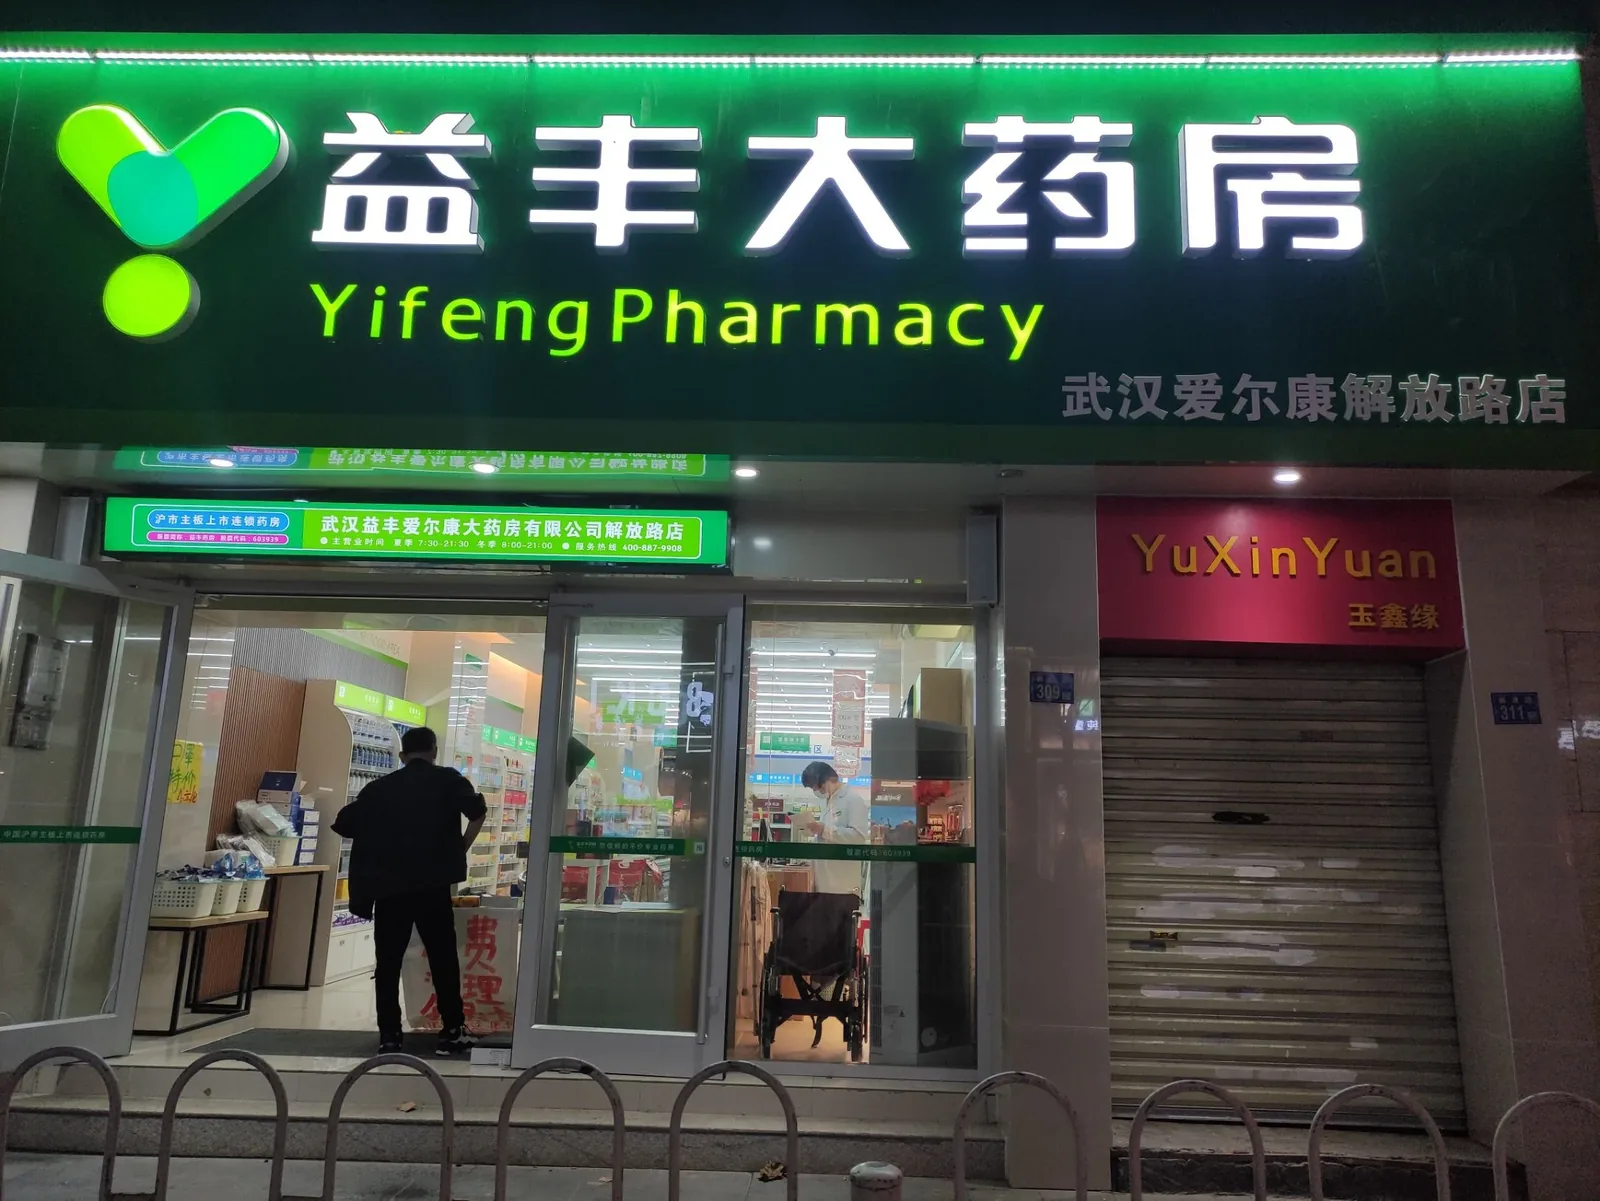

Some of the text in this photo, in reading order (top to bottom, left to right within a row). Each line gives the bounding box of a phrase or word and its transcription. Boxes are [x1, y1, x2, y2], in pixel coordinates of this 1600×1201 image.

[311, 112, 1365, 259] 益丰大药房
[310, 284, 1045, 361] Yifeng Pharmacy
[1061, 372, 1567, 425] 武汉爱尔康解放路店
[154, 513, 281, 529] 沪市主板上市连锁药房
[321, 515, 684, 540] 武汉益丰爱尔康大药房有限公司解放路店
[394, 538, 413, 547] 夏季
[418, 539, 469, 548] 7:30-21:30
[477, 540, 496, 548] 冬季
[501, 541, 553, 550] 8:00-21:00
[575, 542, 683, 552] 服务热线 400-887-9908
[1131, 534, 1437, 579] YuXinYuan
[1349, 603, 1440, 630] 玉鑫缘
[1036, 684, 1060, 700] 309
[1500, 705, 1524, 721] 311
